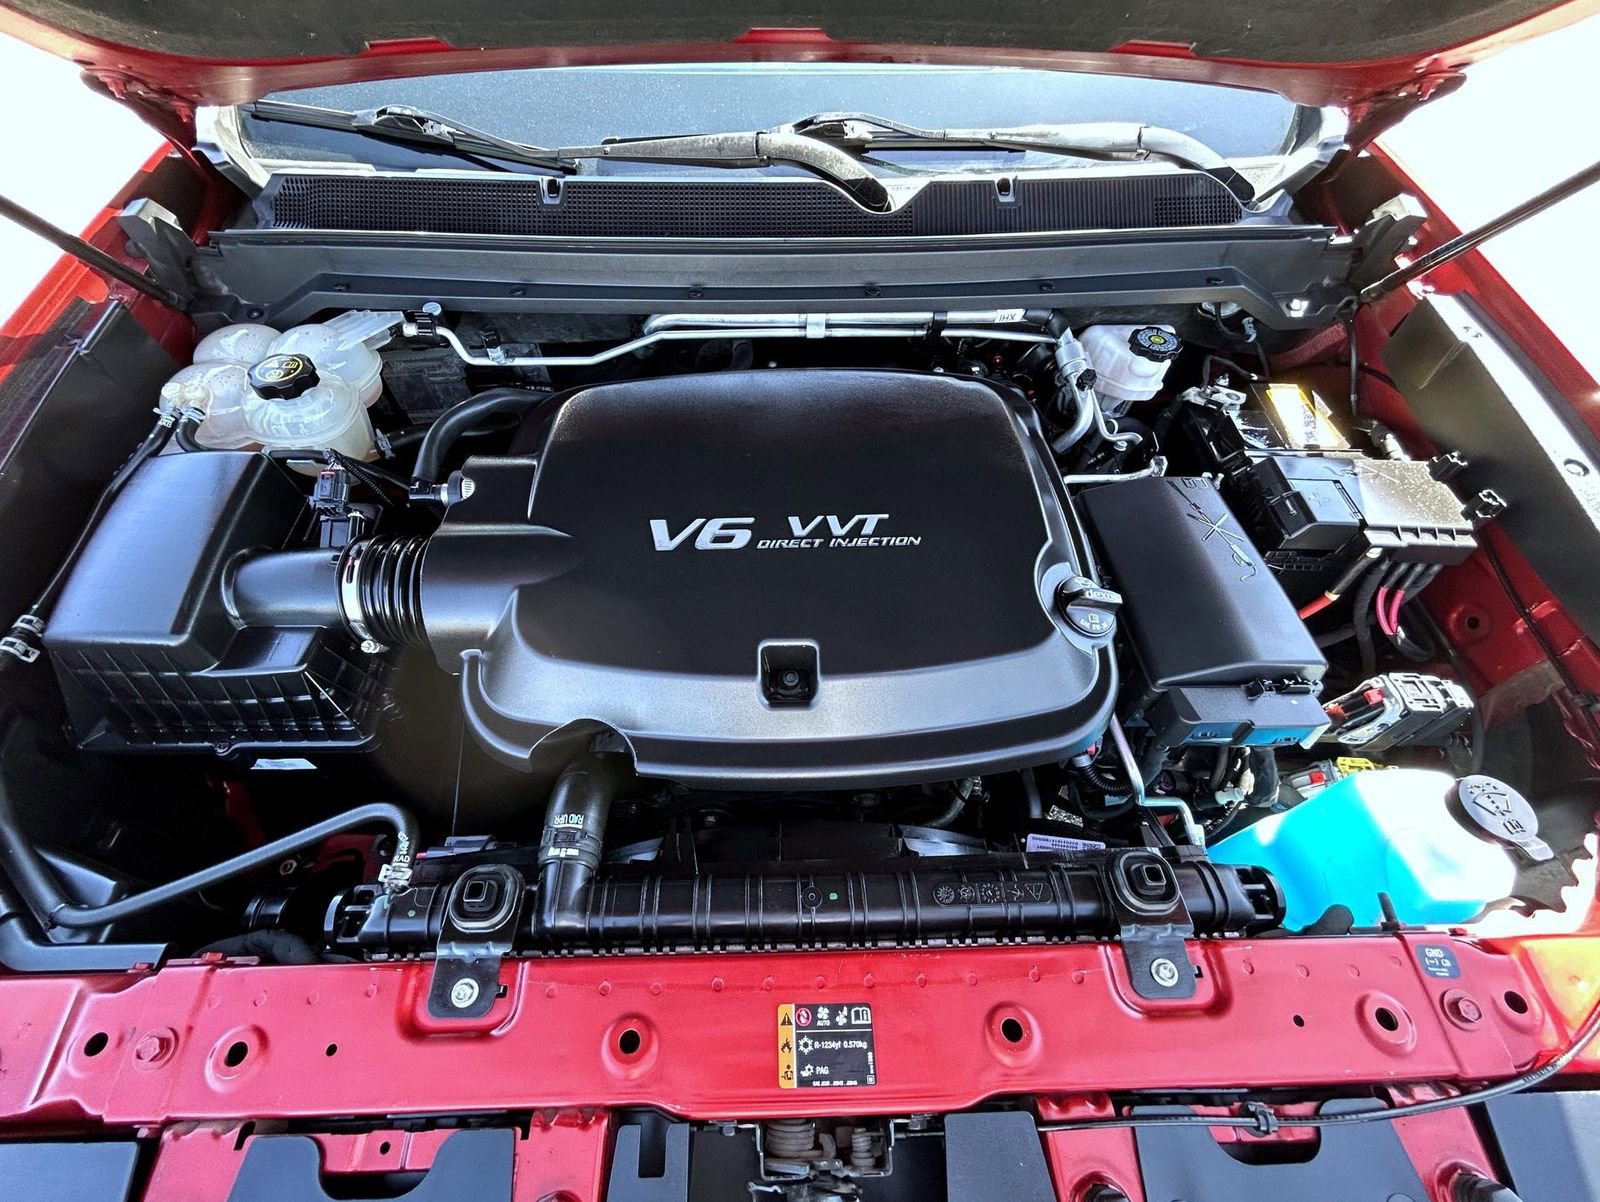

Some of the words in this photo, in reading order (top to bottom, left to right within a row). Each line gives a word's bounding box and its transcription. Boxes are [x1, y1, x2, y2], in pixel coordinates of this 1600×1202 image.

[788, 513, 889, 537] VVT
[650, 517, 755, 551] V6
[757, 538, 823, 549] DIRECT
[829, 536, 921, 548] INJECTION
[393, 855, 410, 863] RAD
[814, 1041, 841, 1050] R-1234yf
[816, 1066, 829, 1075] PAG
